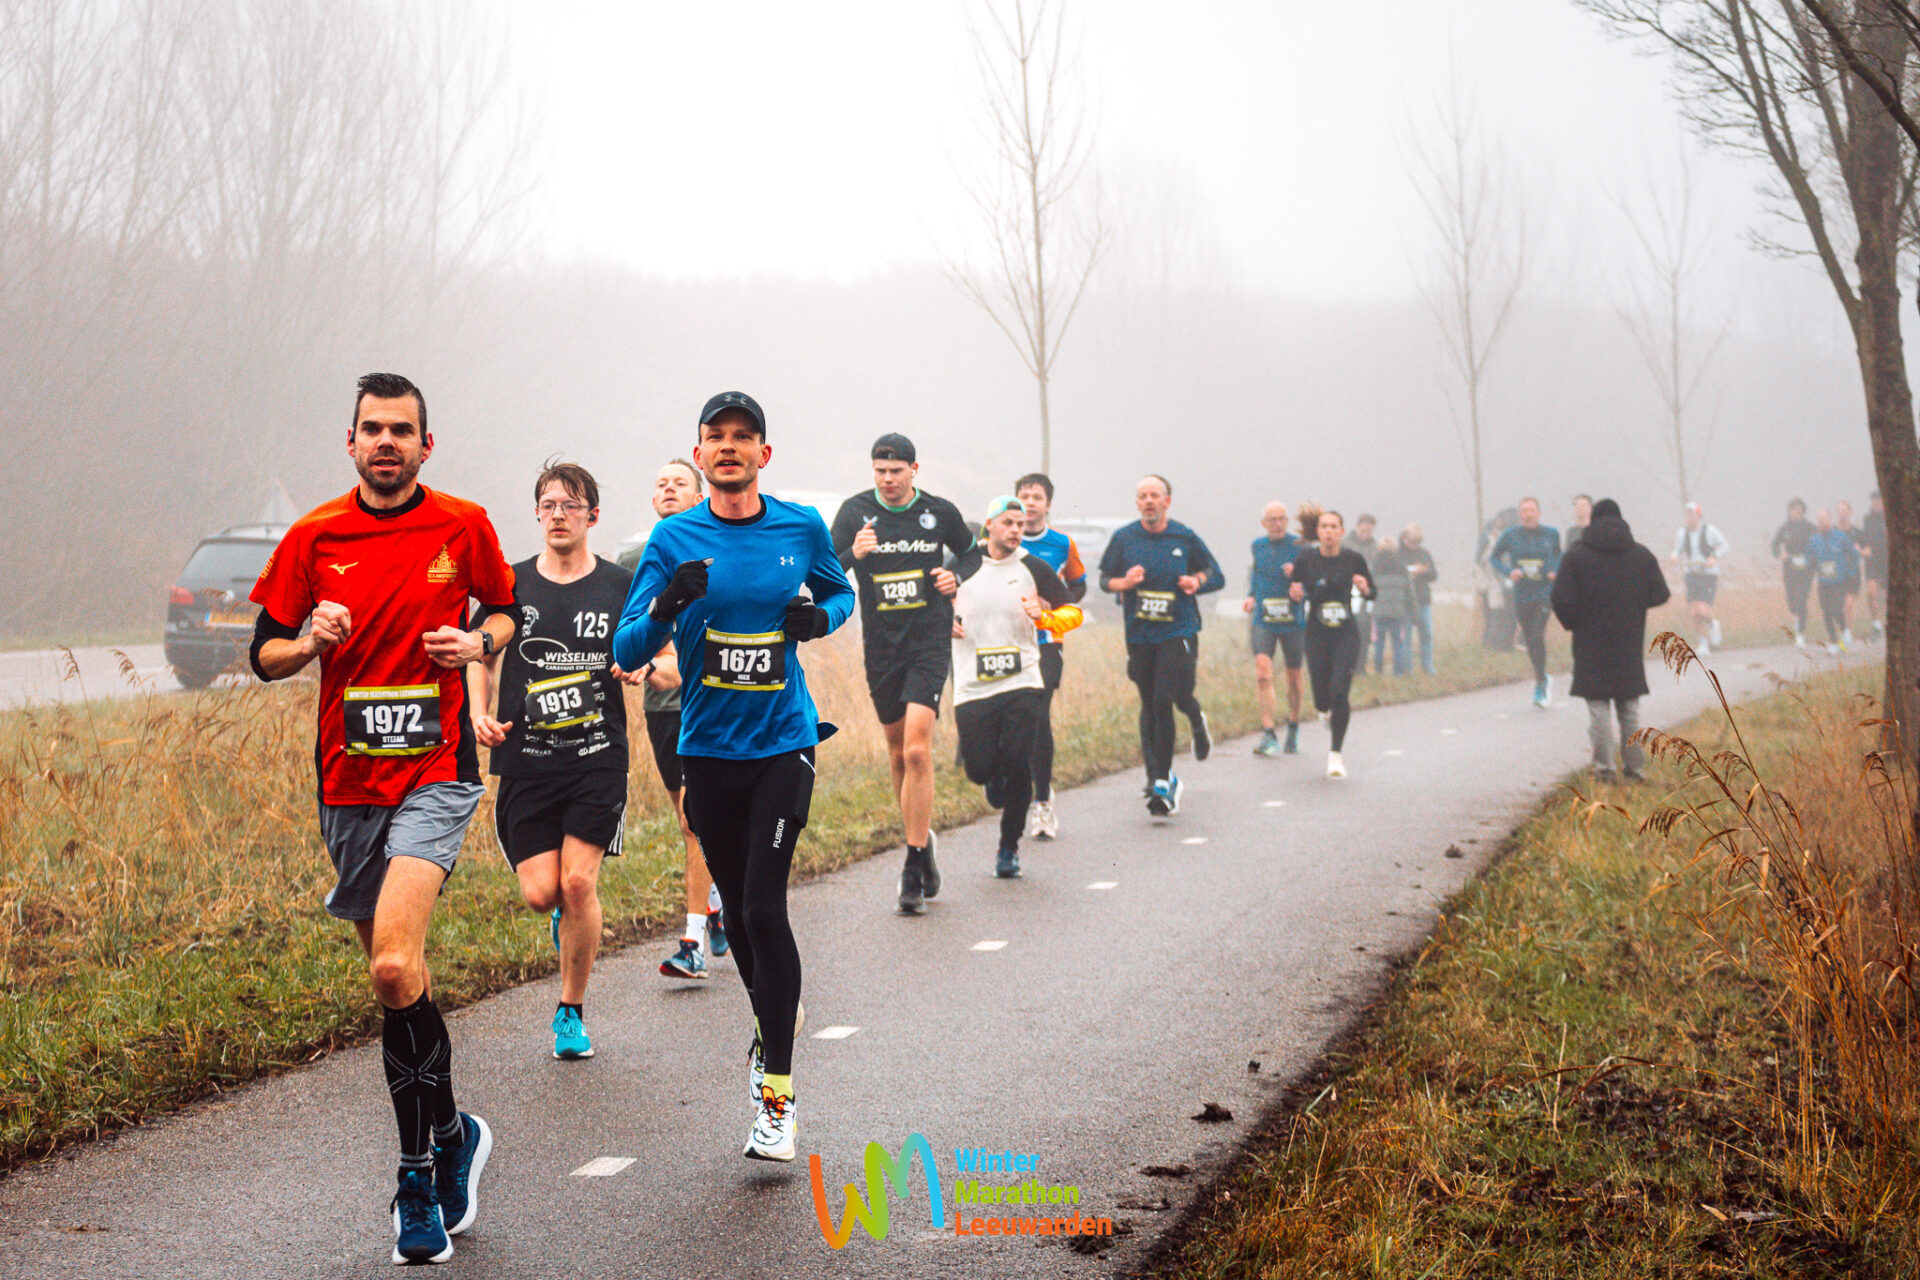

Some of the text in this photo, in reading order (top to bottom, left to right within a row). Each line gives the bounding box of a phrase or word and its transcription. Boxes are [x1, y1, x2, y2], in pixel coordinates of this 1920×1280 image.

[881, 580, 918, 600] 1280
[573, 611, 610, 639] 125
[544, 651, 609, 663] WISSELINK
[718, 648, 772, 673] 1673
[536, 686, 583, 715] 1913
[361, 703, 424, 734] 1972
[772, 817, 786, 849] FUSION
